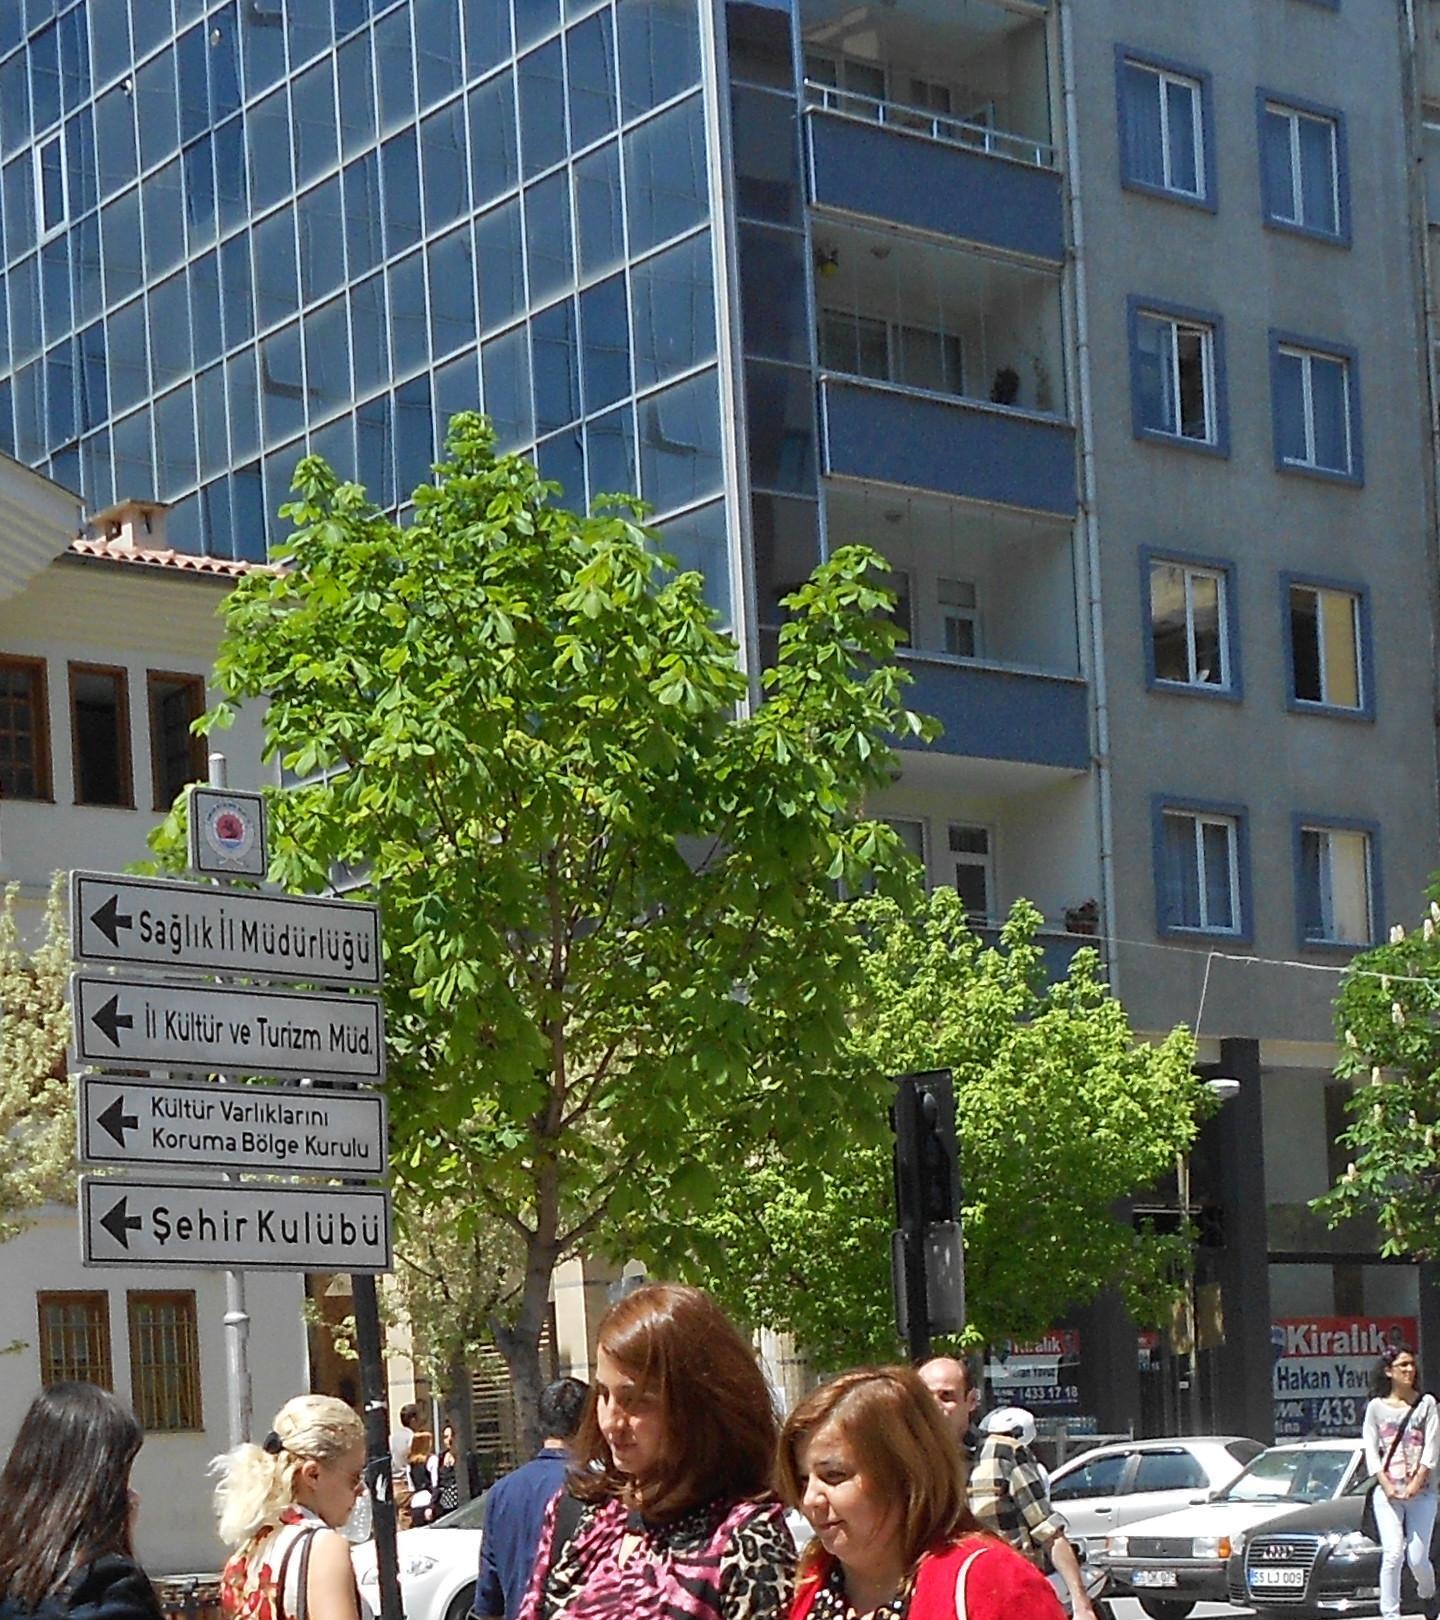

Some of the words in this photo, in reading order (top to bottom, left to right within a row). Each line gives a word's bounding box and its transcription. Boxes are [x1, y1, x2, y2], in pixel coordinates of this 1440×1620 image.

[139, 909, 214, 955] Sağlık
[219, 907, 235, 950] İl
[240, 918, 370, 971] Müdürlüğü
[144, 1001, 157, 1041] İl
[164, 1007, 224, 1044] Kültür
[229, 1024, 251, 1046] ve
[256, 1017, 322, 1052] Turizm
[328, 1024, 374, 1056] Müd.
[151, 1095, 215, 1124] Kültür
[220, 1099, 329, 1127] Varlıklarını
[151, 1126, 237, 1153] Koruma
[242, 1128, 300, 1160] Bölge
[305, 1133, 369, 1160] Kurulu
[151, 1206, 249, 1246] Şehir
[257, 1209, 380, 1246] Kulübü
[1287, 1323, 1387, 1355] Kiralık
[1024, 1387, 1045, 1400] 433
[1048, 1386, 1061, 1399] 17
[1065, 1385, 1078, 1398] 18
[1277, 1366, 1330, 1391] Hakan
[1318, 1397, 1357, 1426] 433
[1267, 1572, 1280, 1585] LJ
[1283, 1572, 1302, 1585] 009
